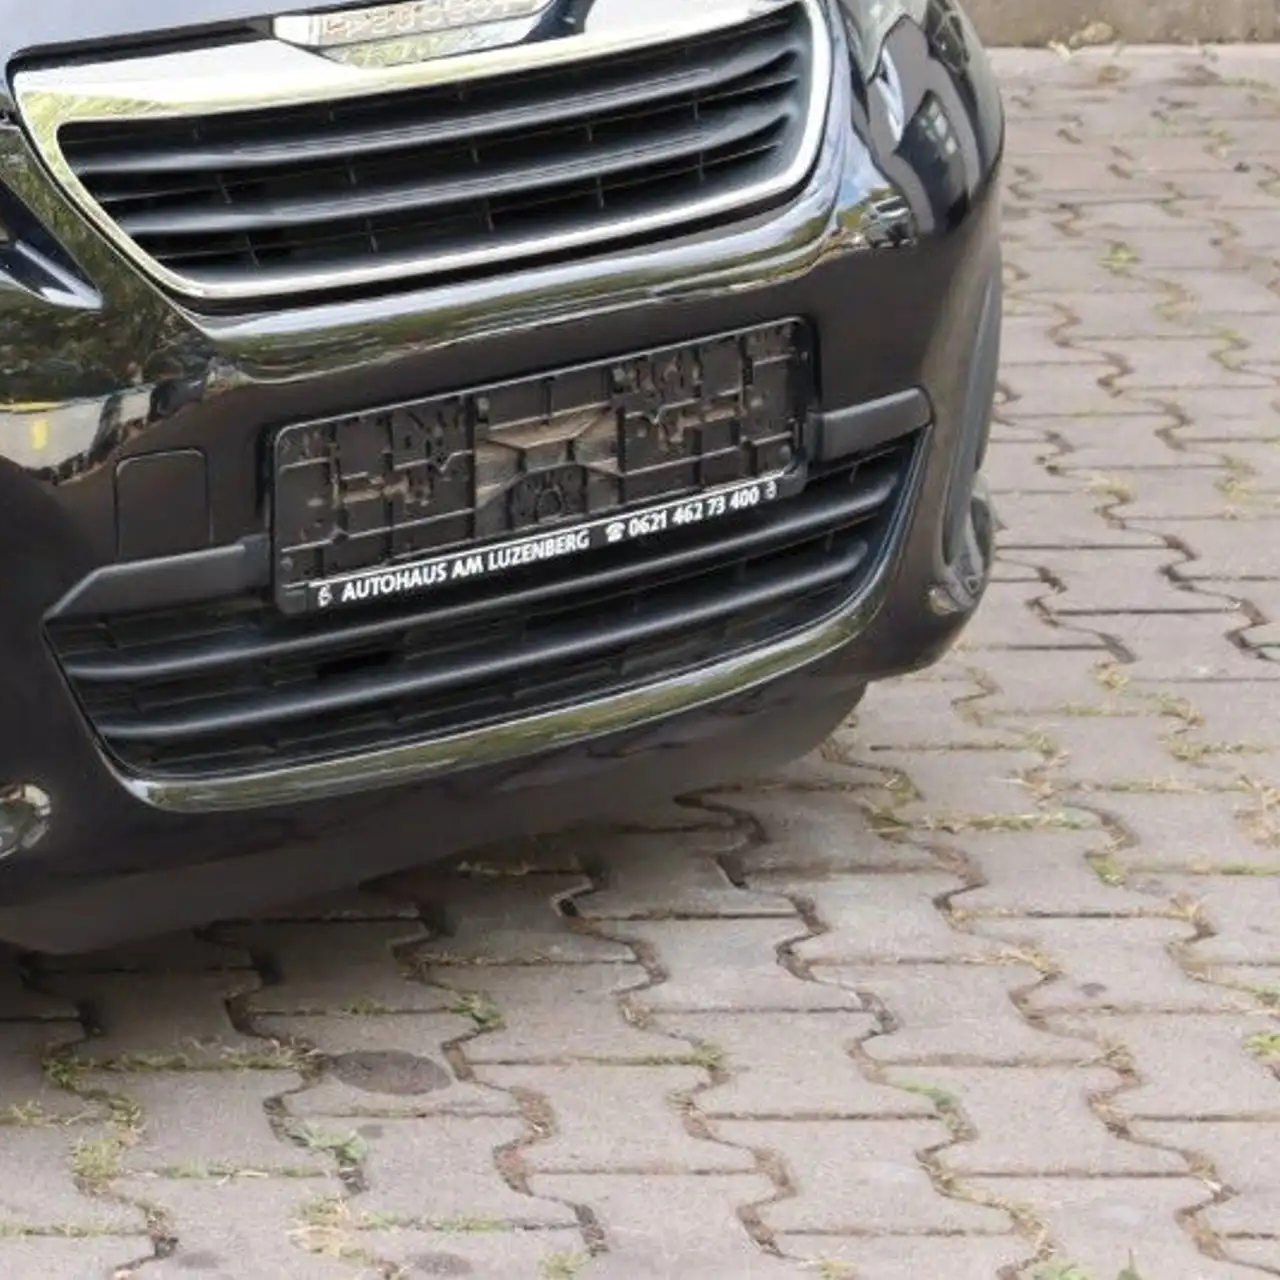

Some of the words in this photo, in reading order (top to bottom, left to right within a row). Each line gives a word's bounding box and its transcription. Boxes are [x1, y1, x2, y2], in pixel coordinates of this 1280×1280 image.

[341, 562, 447, 603] AUTOHAUS
[451, 556, 484, 579] AM
[487, 530, 590, 571] LUZENBERG
[628, 510, 669, 537] 0621
[672, 501, 704, 525] 462
[706, 495, 726, 516] 73
[729, 486, 761, 510] 400
